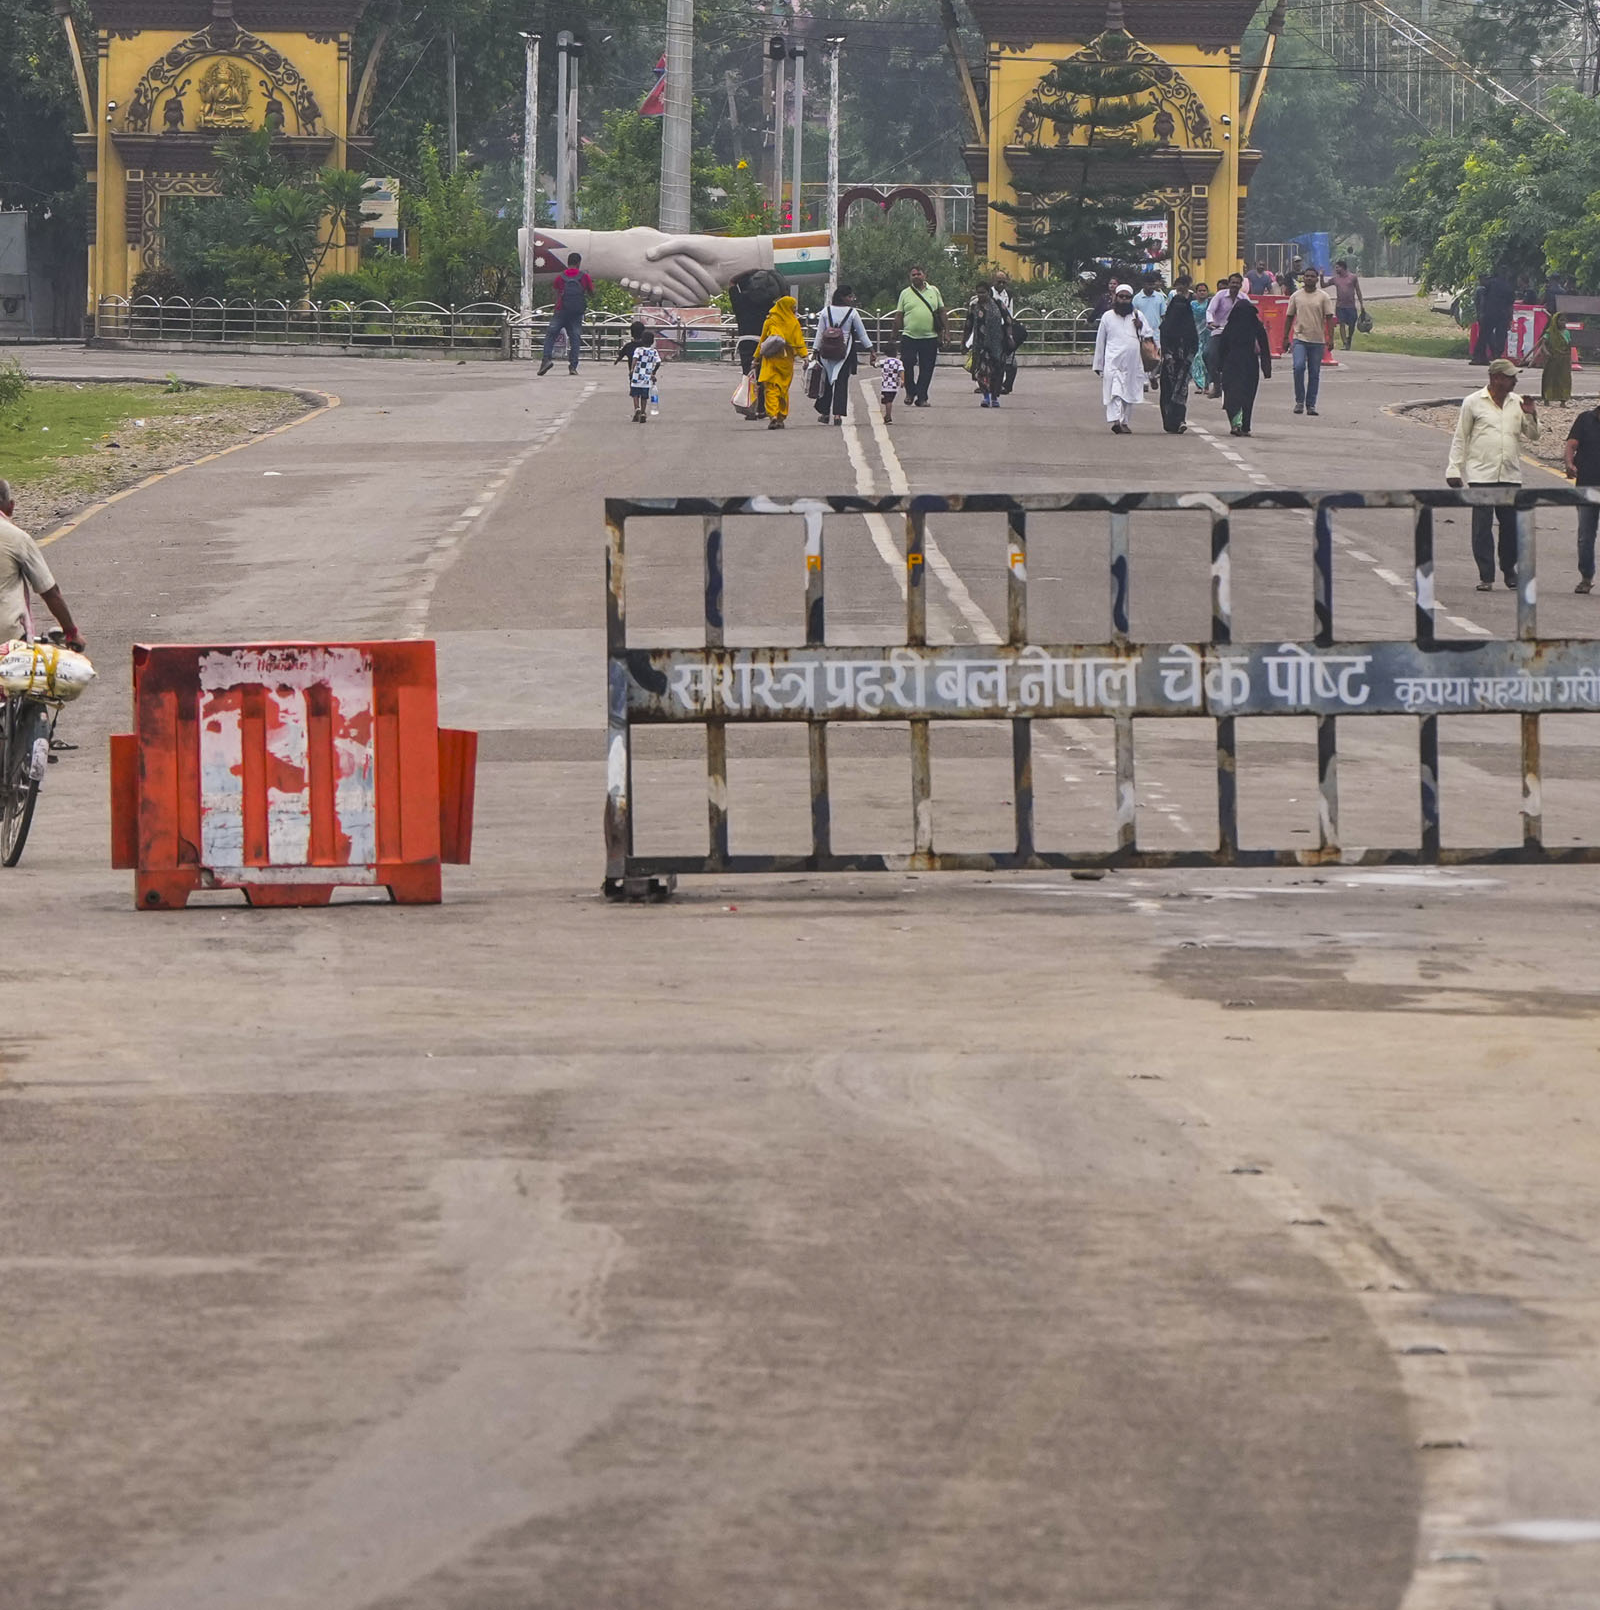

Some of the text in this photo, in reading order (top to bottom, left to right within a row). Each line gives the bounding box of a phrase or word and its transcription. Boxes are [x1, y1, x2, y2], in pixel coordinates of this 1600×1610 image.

[824, 648, 930, 714] प्रहरी
[1017, 645, 1142, 707] नेपाल
[1158, 644, 1249, 706] चेक
[1393, 676, 1470, 713] कृपया
[1473, 668, 1554, 709] सहयोग
